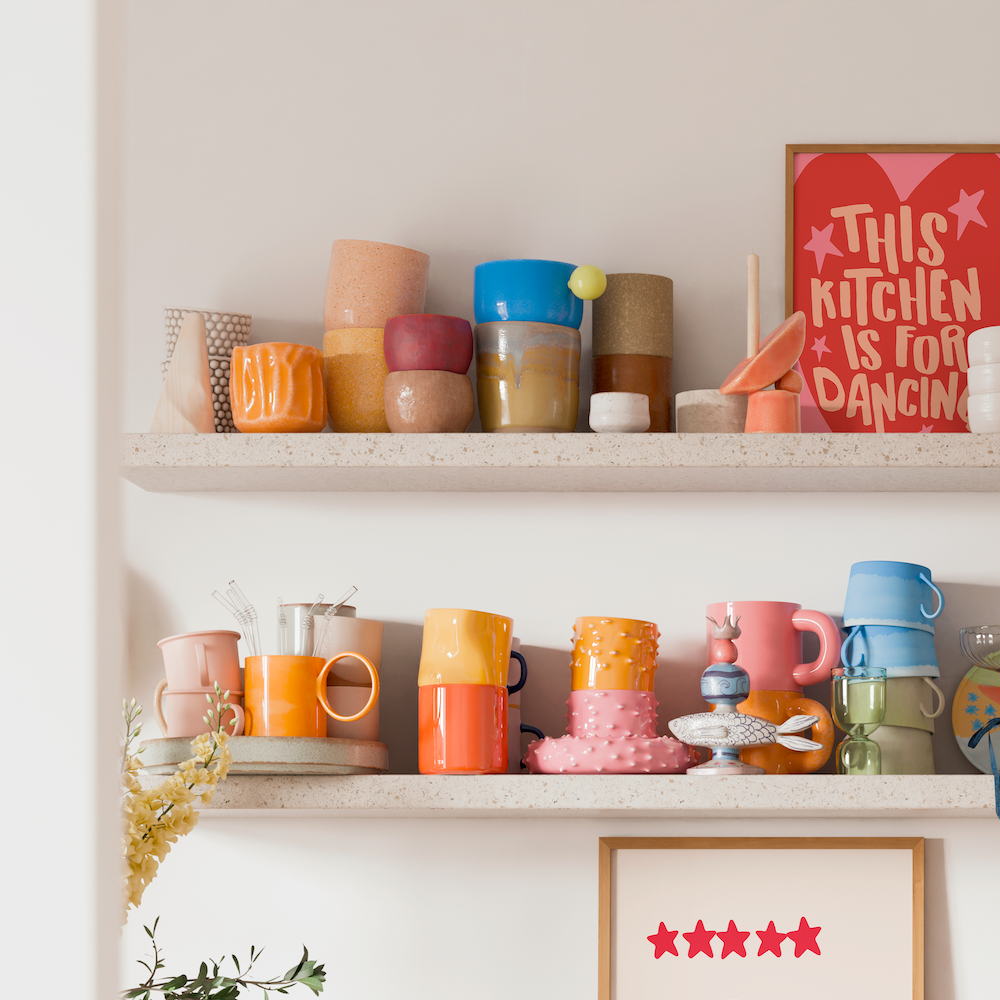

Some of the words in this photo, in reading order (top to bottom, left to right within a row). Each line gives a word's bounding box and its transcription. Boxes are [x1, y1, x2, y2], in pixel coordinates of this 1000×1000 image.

[831, 203, 948, 275] THIS
[811, 266, 981, 328] KITCHEN
[841, 324, 882, 371] IS
[896, 324, 969, 375] FOR
